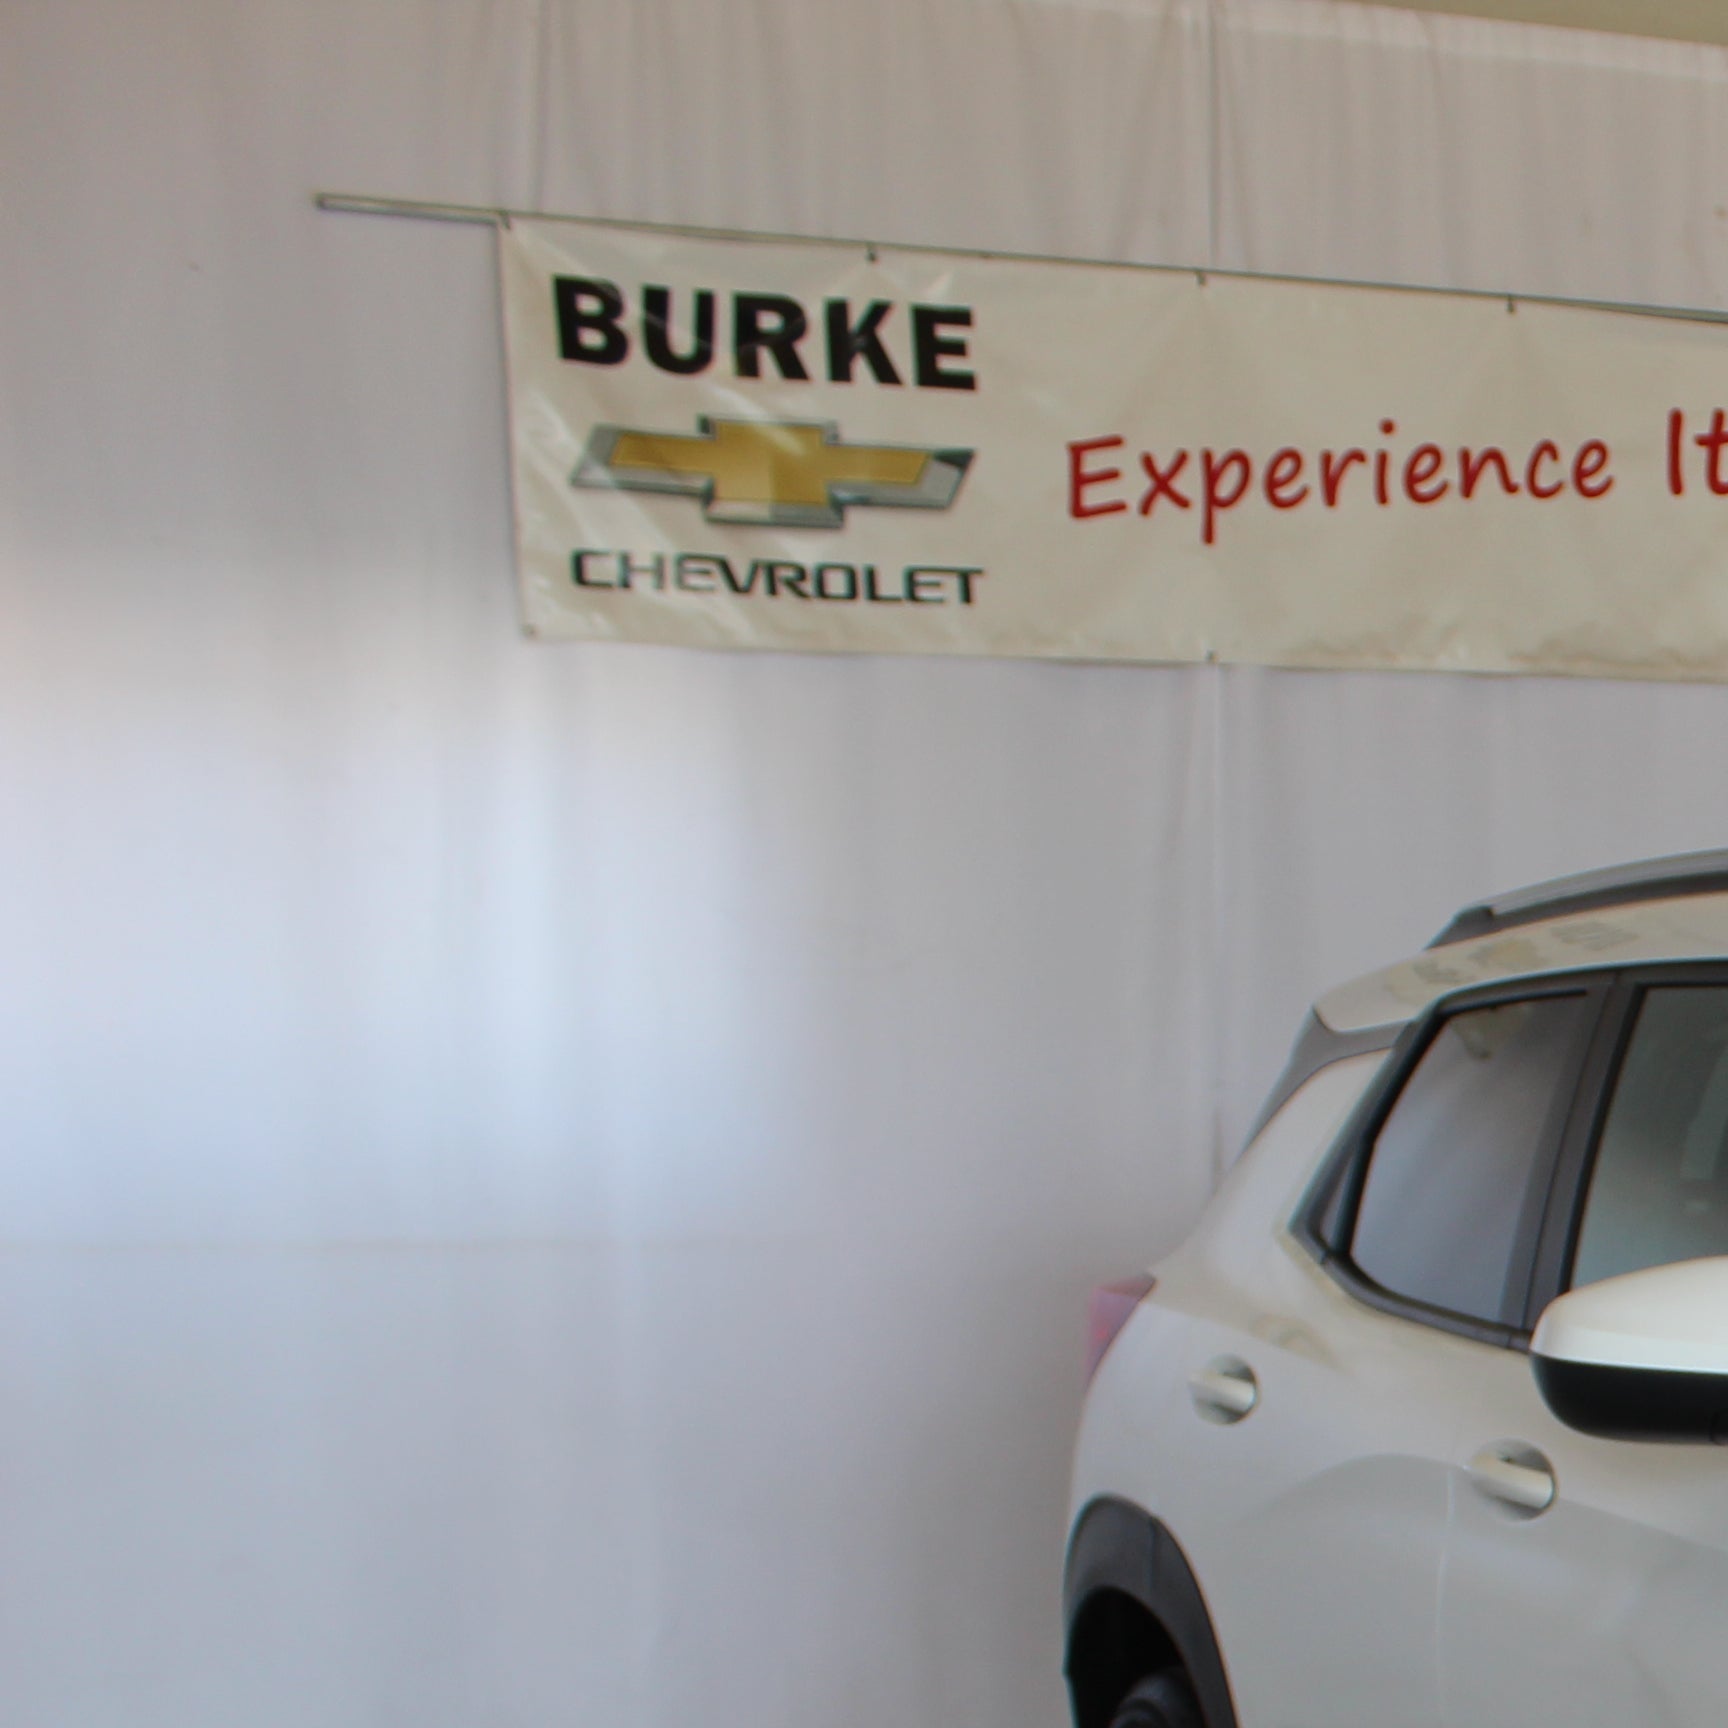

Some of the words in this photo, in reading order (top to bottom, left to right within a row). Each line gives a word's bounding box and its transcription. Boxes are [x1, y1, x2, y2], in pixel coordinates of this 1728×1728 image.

[551, 273, 978, 391] BURKE
[1066, 419, 1614, 545] Experience
[571, 549, 983, 605] CHEVROLET
